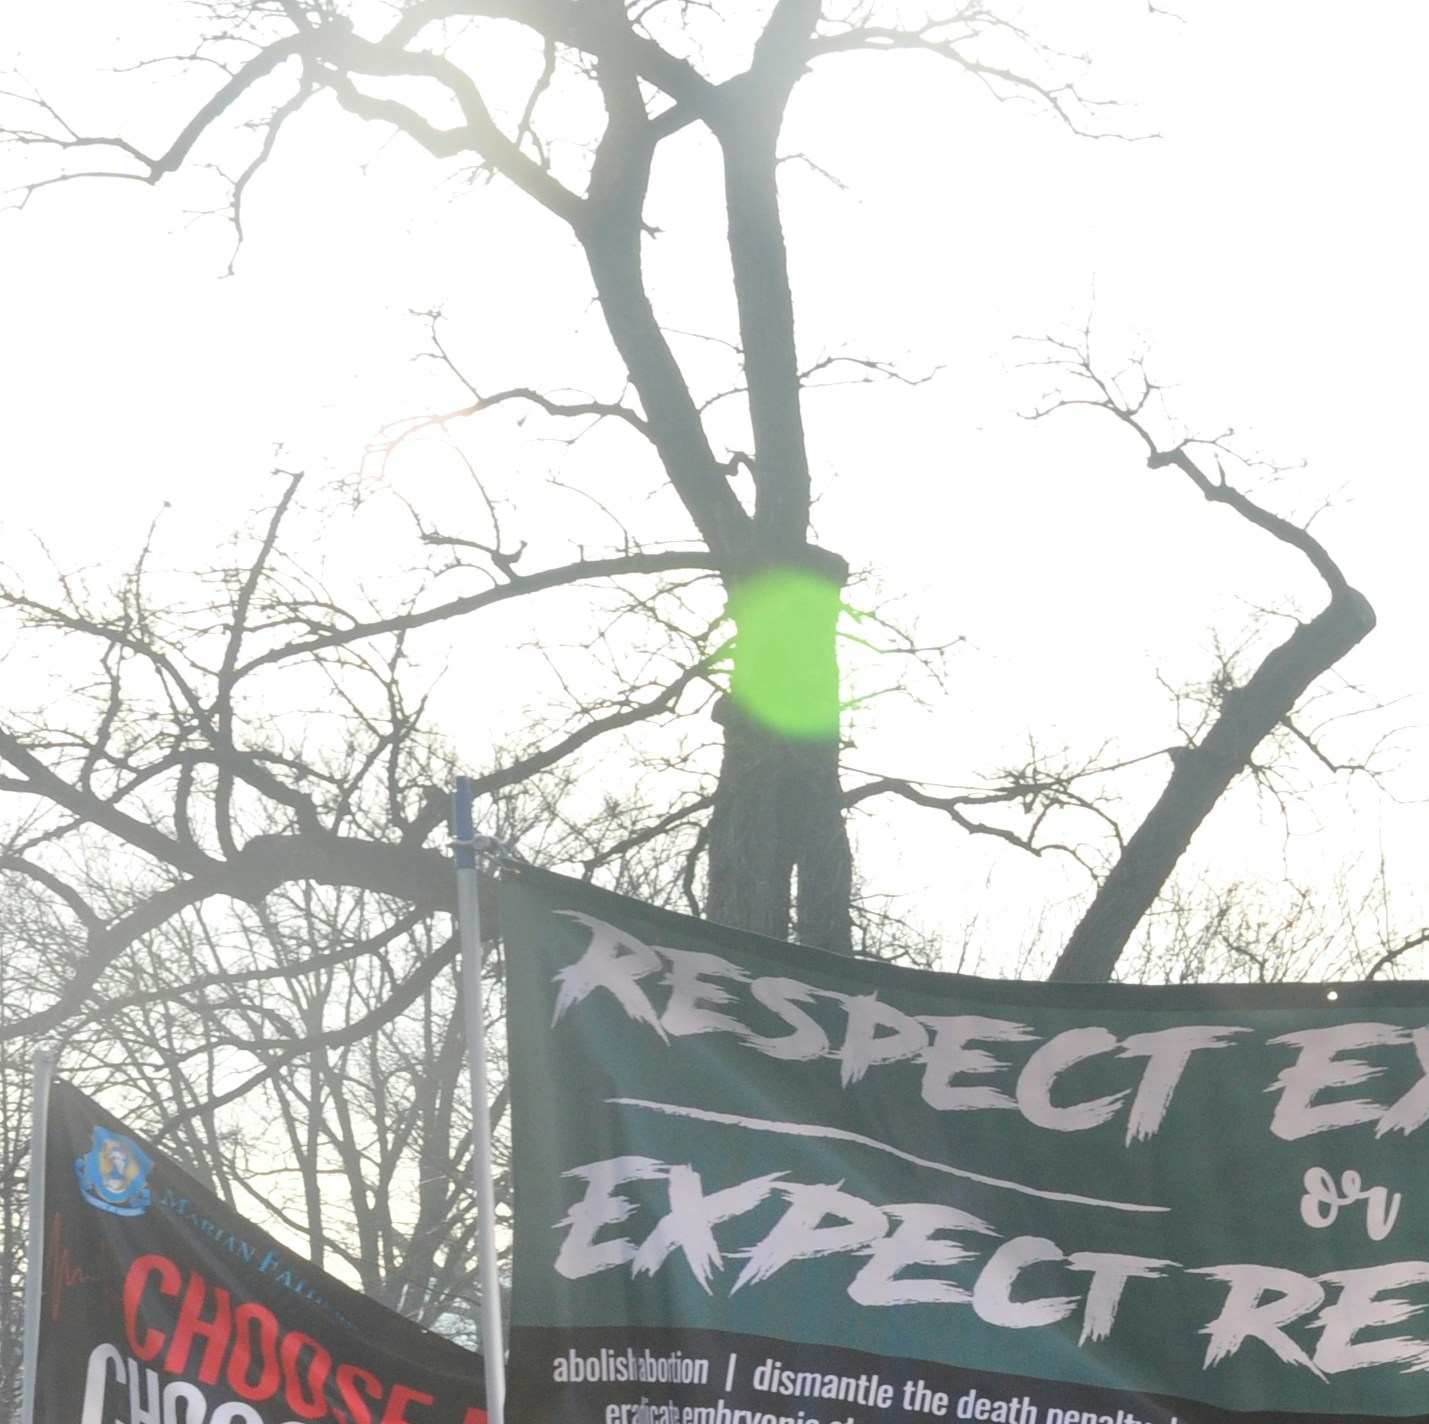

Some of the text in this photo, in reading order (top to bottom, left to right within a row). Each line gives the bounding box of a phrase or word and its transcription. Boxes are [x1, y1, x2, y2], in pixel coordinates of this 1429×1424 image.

[552, 909, 1254, 1147] RESPECT
[553, 1155, 1184, 1347] EXPECT
[1300, 1166, 1400, 1241] or
[753, 1358, 894, 1409] dismantle
[902, 1380, 948, 1417] the
